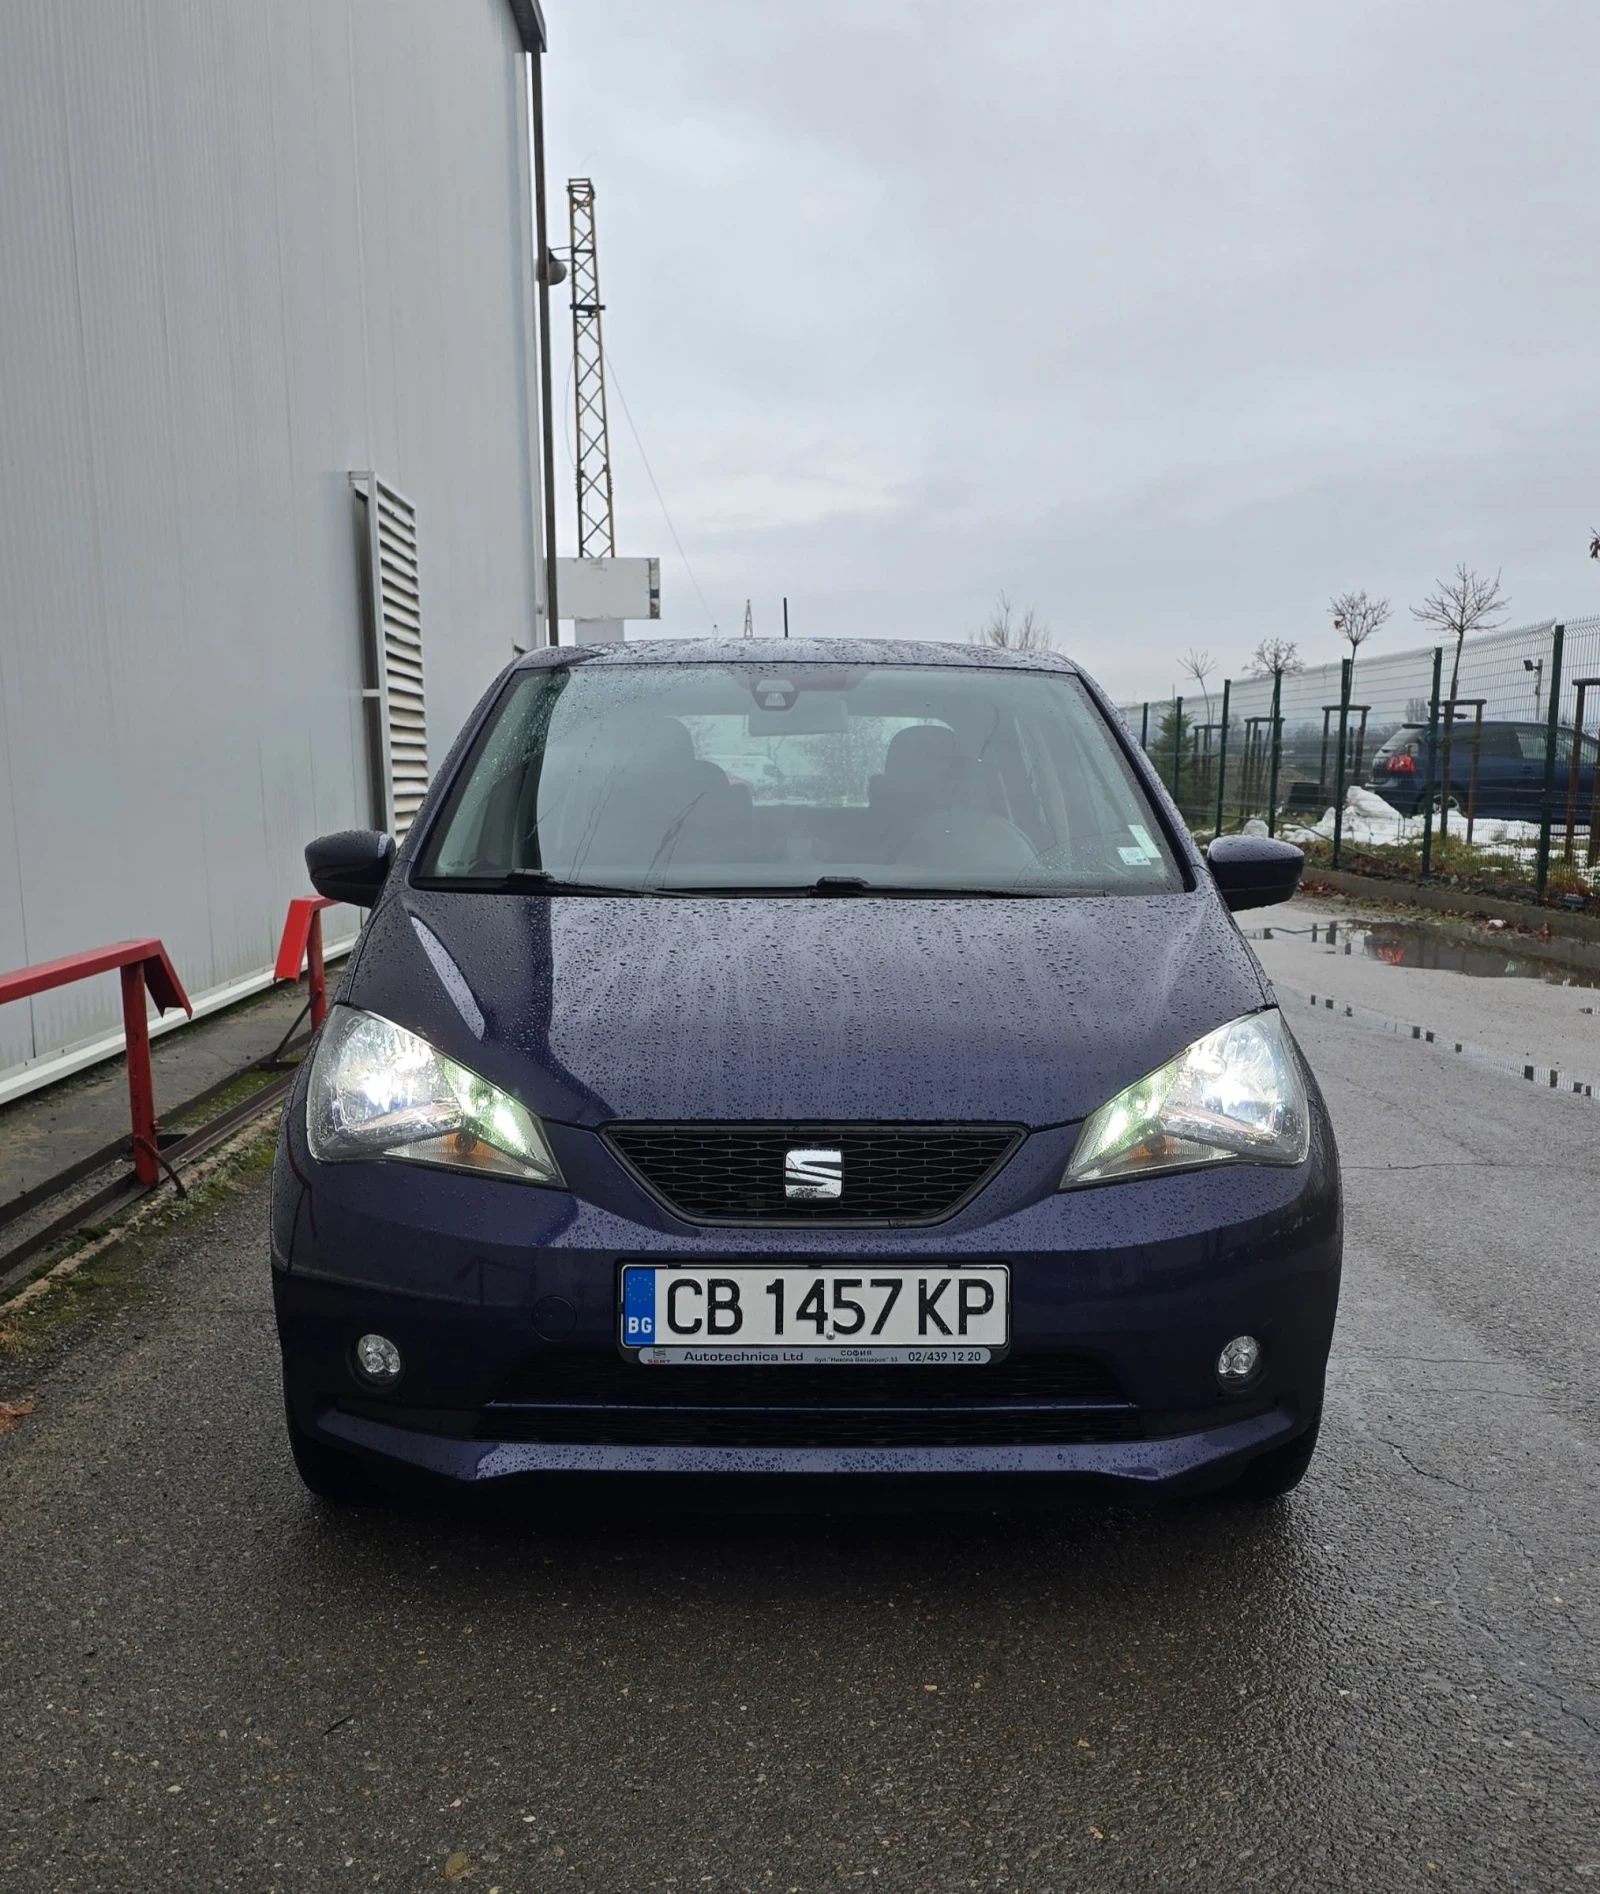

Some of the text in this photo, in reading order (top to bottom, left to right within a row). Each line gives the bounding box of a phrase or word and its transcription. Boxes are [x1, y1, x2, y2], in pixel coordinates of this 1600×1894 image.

[667, 1278, 994, 1335] CB 1457 KP
[628, 1317, 652, 1333] BG
[683, 1351, 804, 1361] Autotechnica Ltd
[908, 1351, 981, 1362] 02/439 12 20
